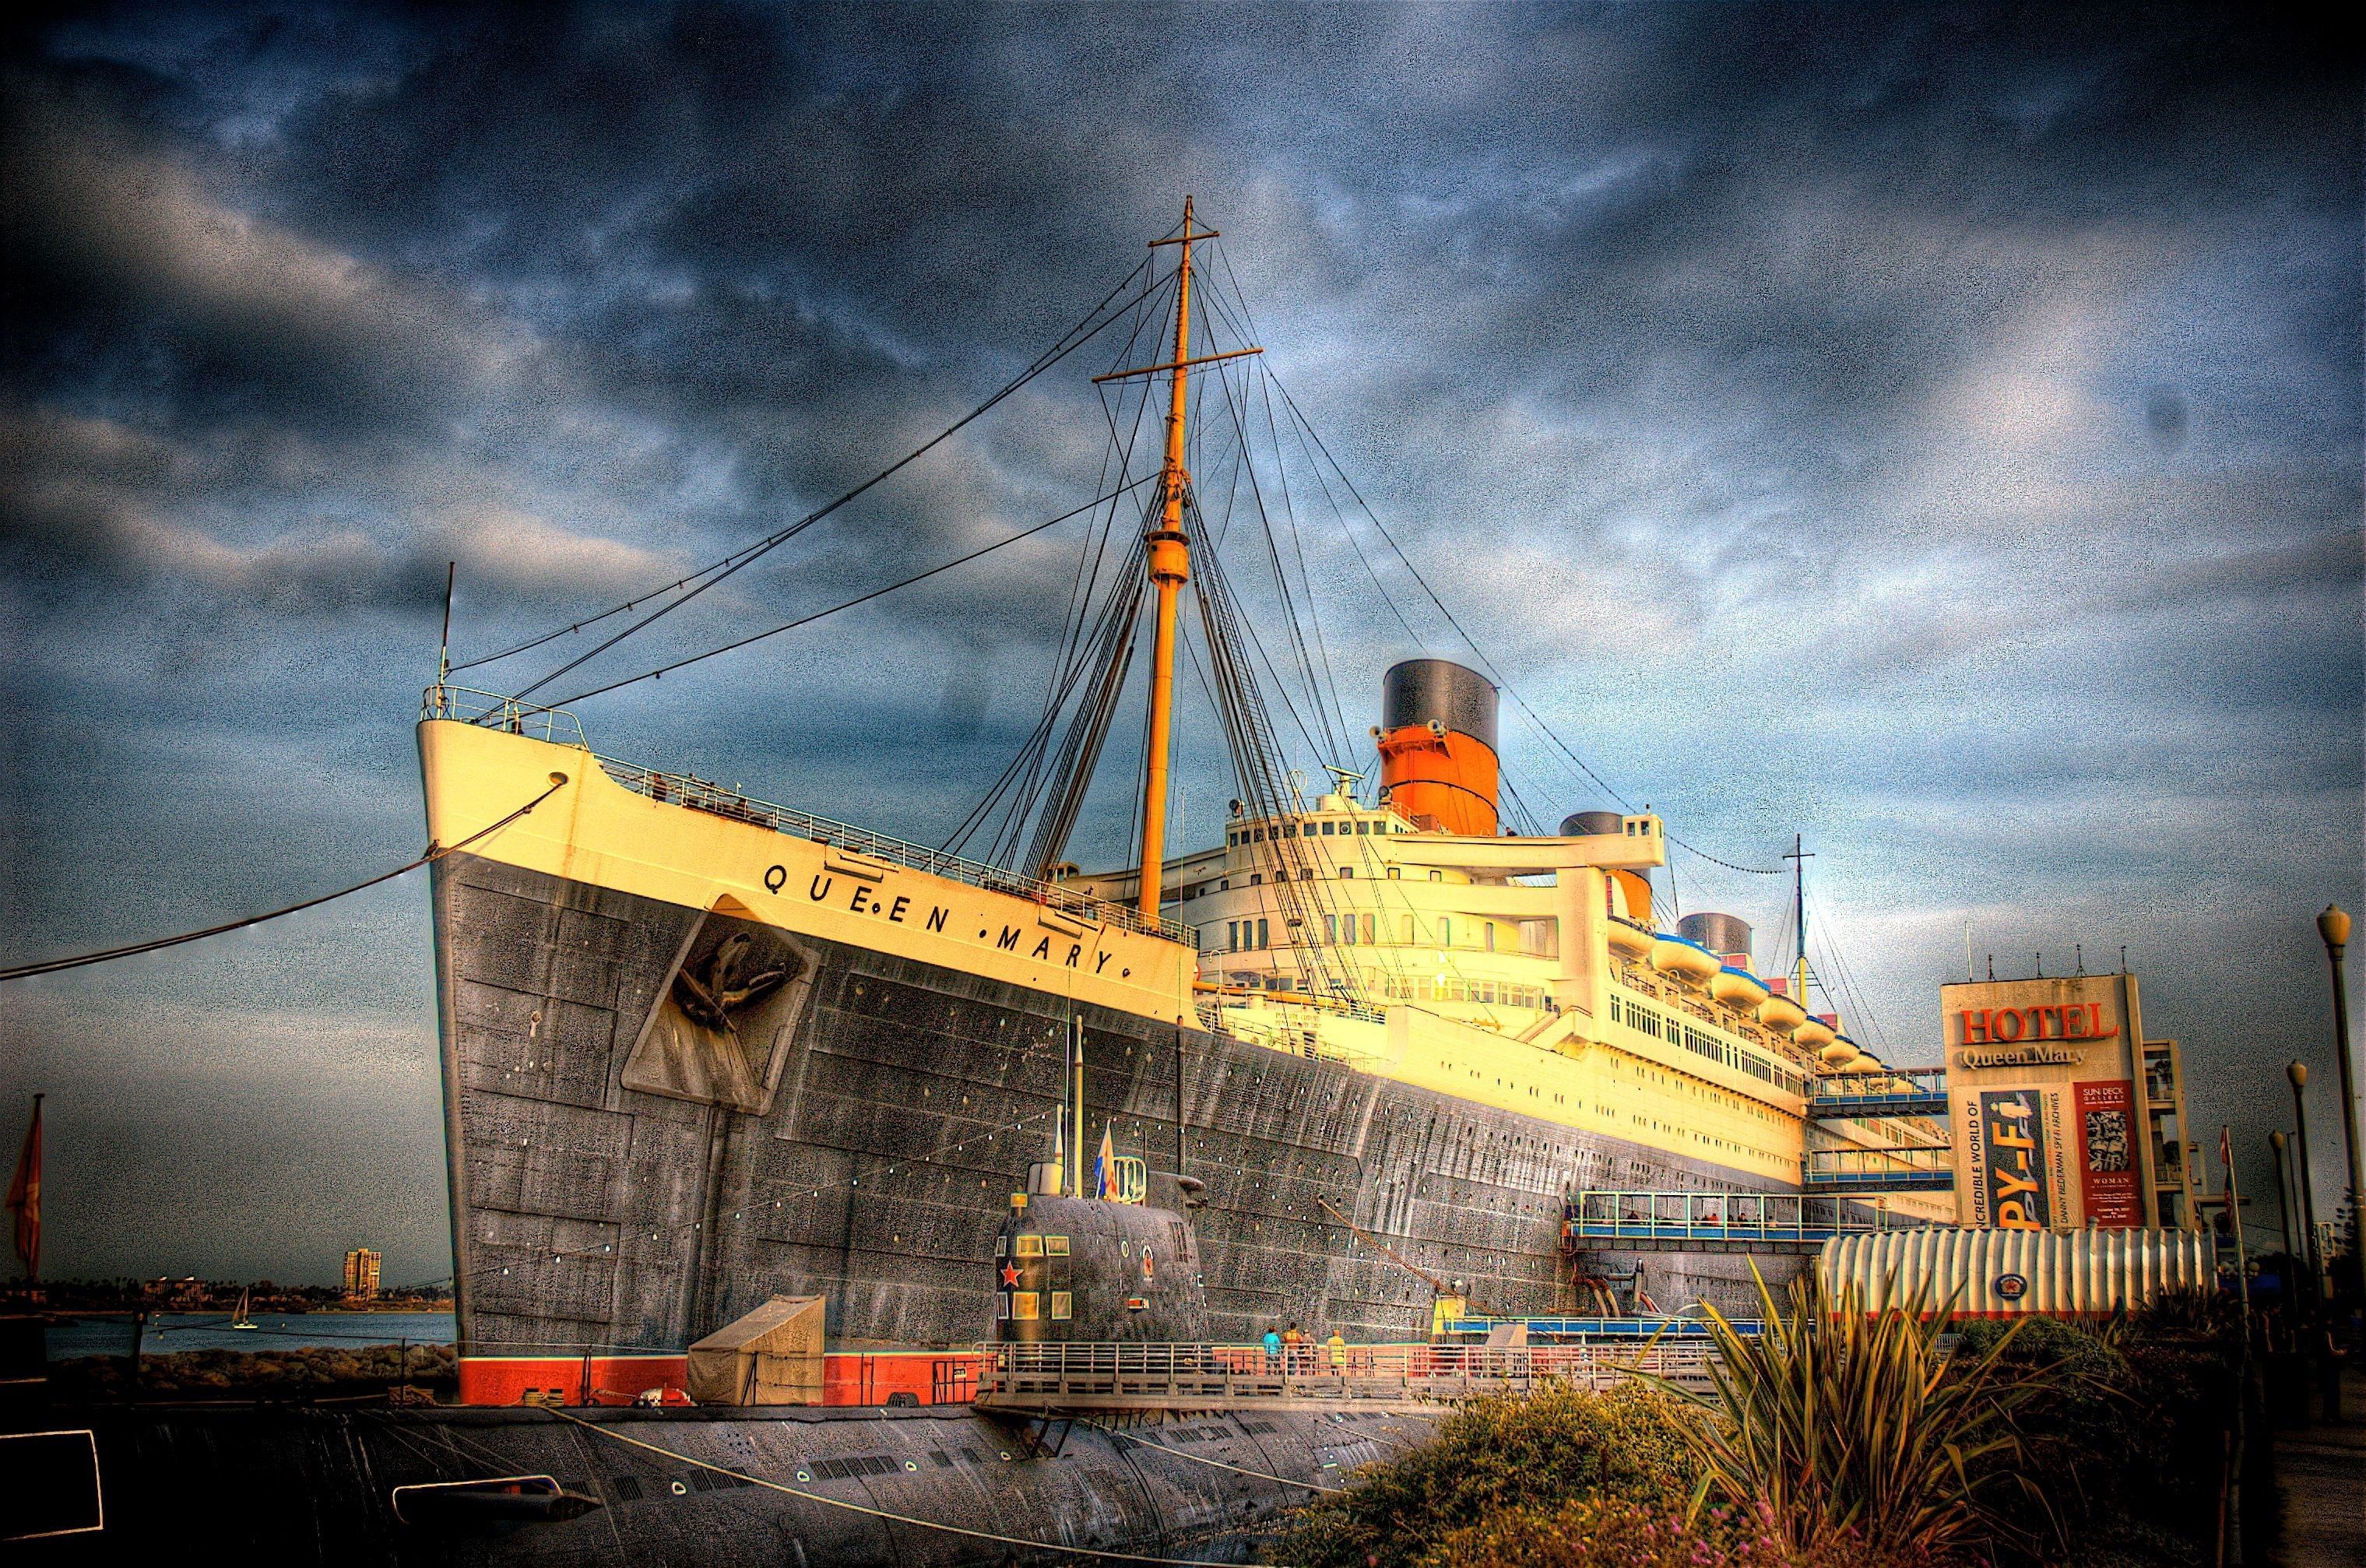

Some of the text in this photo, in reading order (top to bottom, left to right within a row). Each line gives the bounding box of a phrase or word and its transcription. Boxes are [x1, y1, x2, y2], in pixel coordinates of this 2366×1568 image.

[764, 864, 1112, 976] QUEEN MARY
[1960, 1003, 2120, 1045] HOTEL
[1962, 1045, 2087, 1071] Queen Mary
[2051, 1093, 2059, 1128] ARCHIVES
[2083, 1088, 2101, 1096] SUN
[1967, 1100, 1986, 1230] NCREDIBLE WORLD OF
